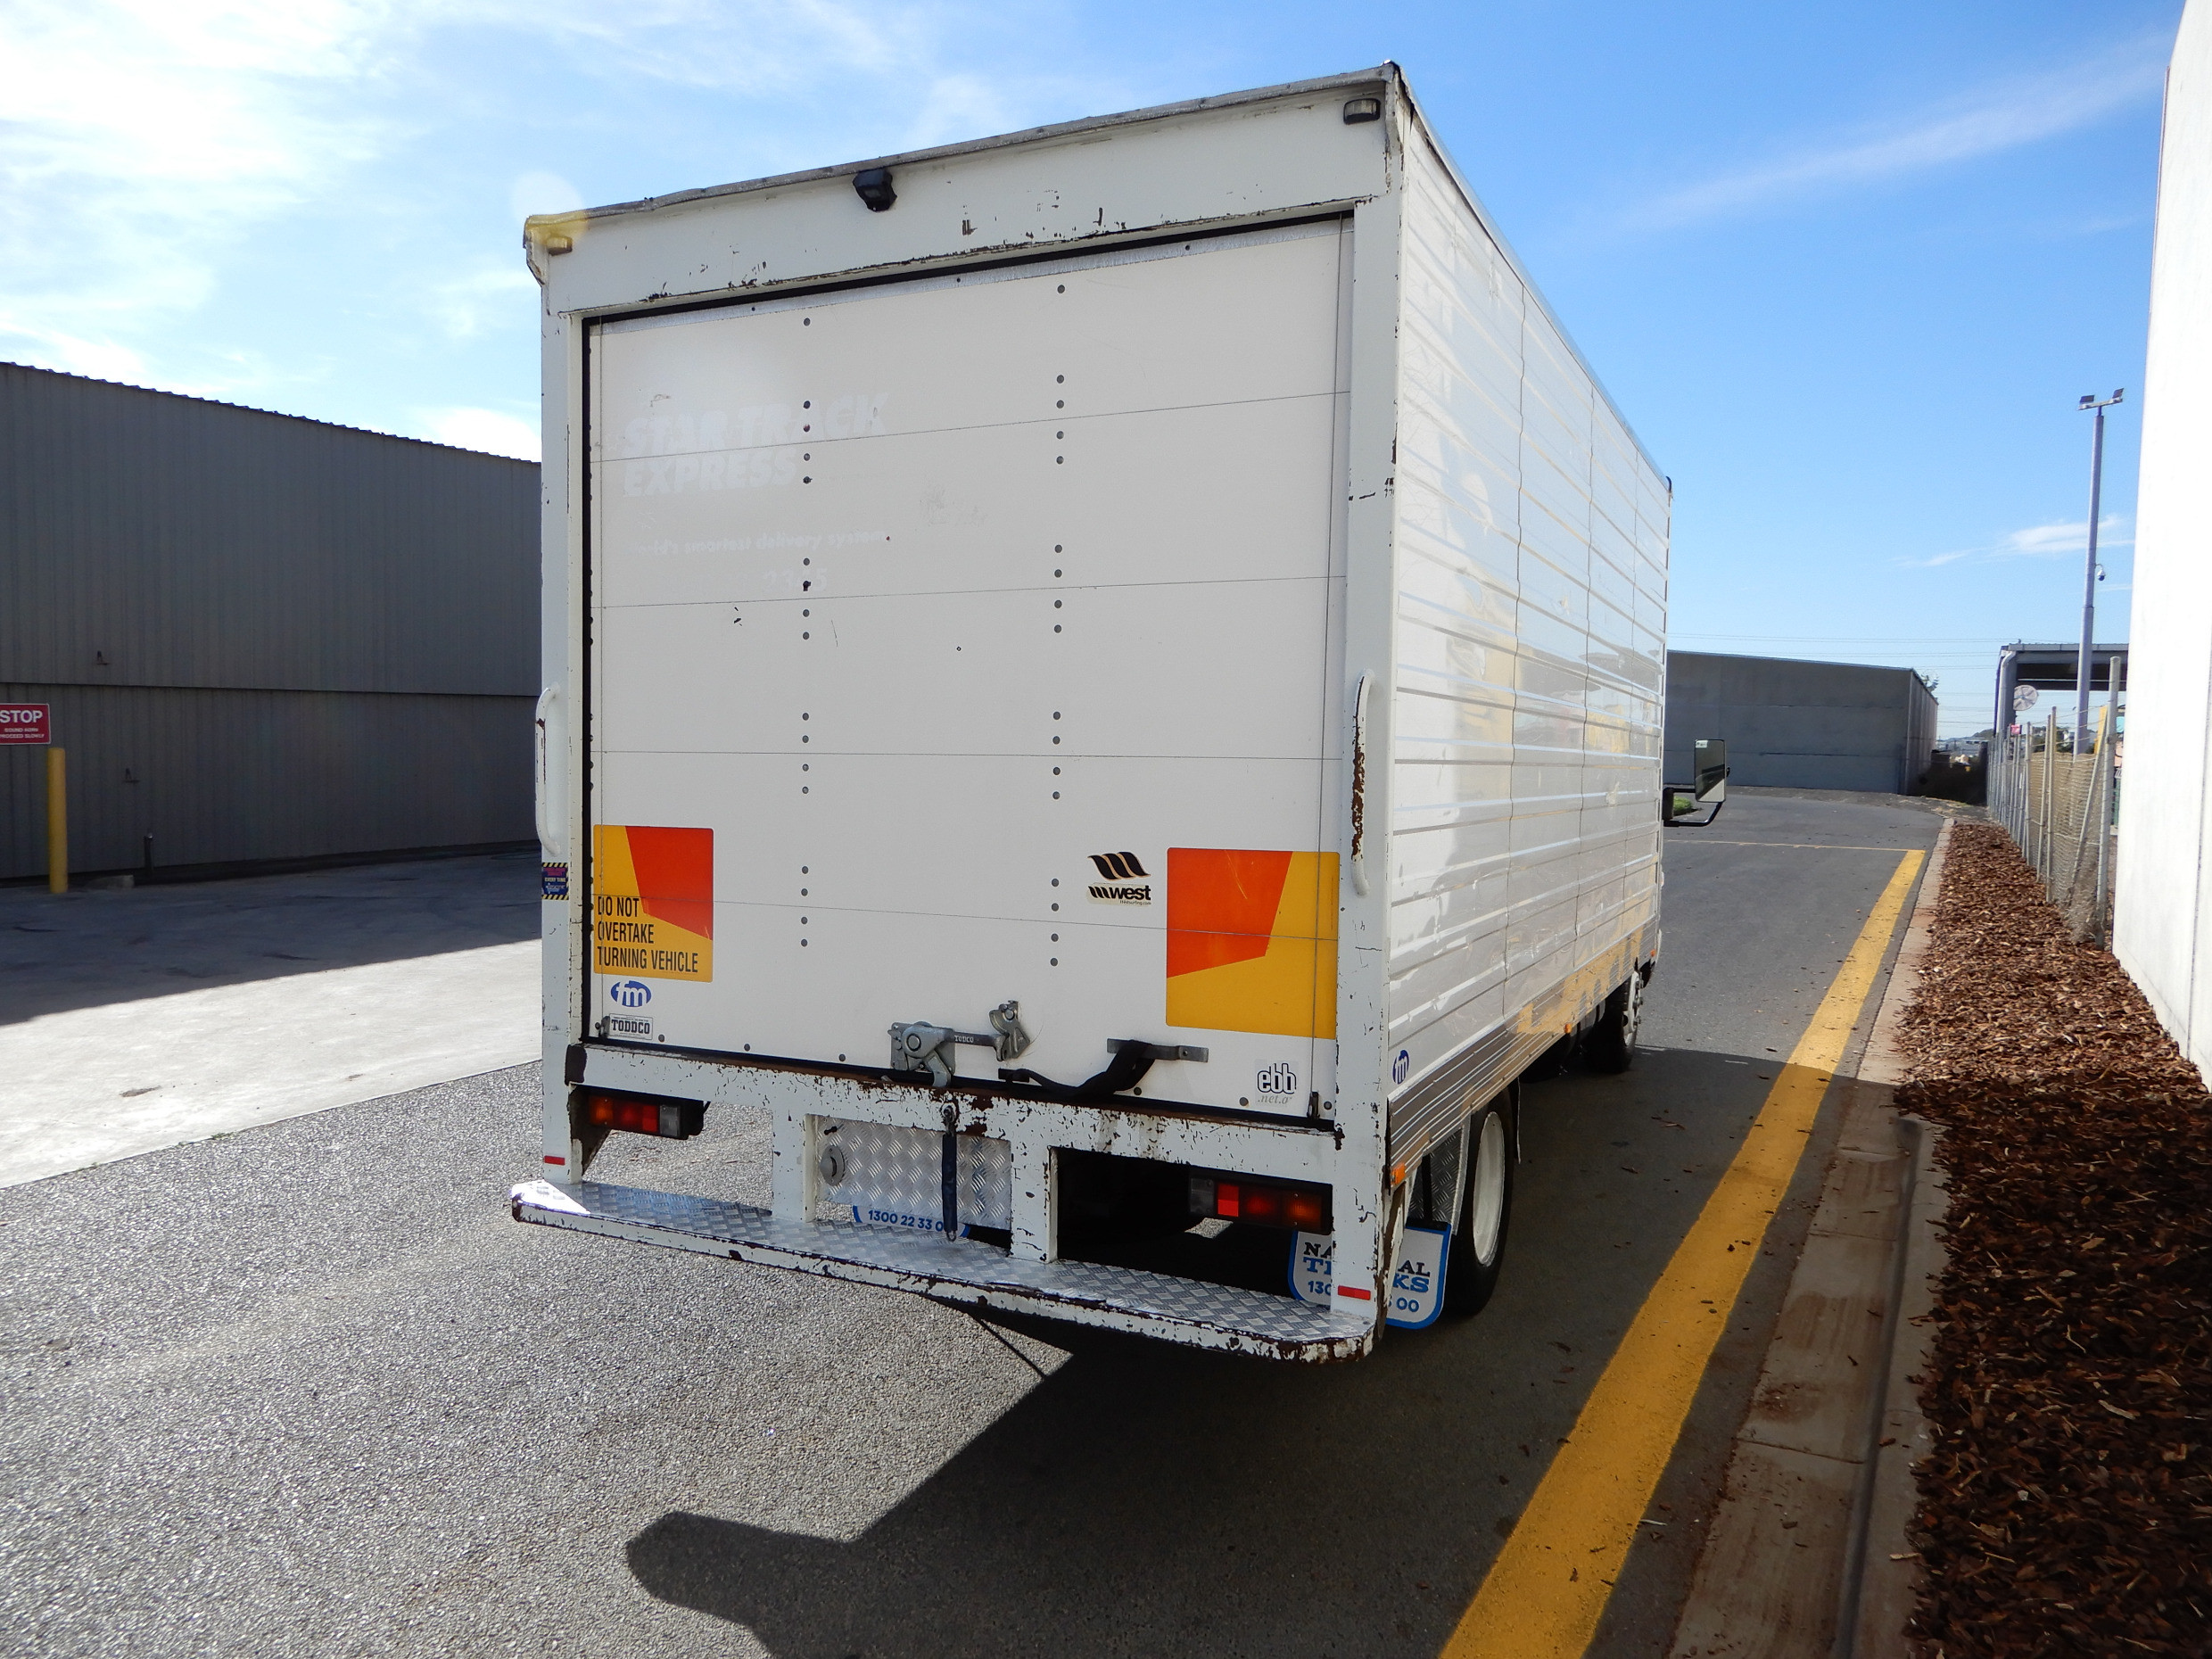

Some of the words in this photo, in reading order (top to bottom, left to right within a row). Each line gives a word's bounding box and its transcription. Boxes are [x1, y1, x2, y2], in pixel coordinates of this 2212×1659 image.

[738, 392, 889, 443] TRACK
[623, 448, 798, 498] EXPRESS
[0, 710, 43, 723] STOP
[1109, 885, 1151, 901] west
[598, 896, 613, 916] DO
[616, 896, 640, 918] NOT
[597, 920, 655, 945] OVERTAKE
[597, 945, 648, 970] TURNING
[650, 949, 698, 973] VEHICLE
[611, 1019, 650, 1035] TODDCO
[868, 1209, 898, 1225] 1300
[900, 1215, 915, 1227] 22
[917, 1217, 933, 1230] 33
[935, 1221, 944, 1232] 0
